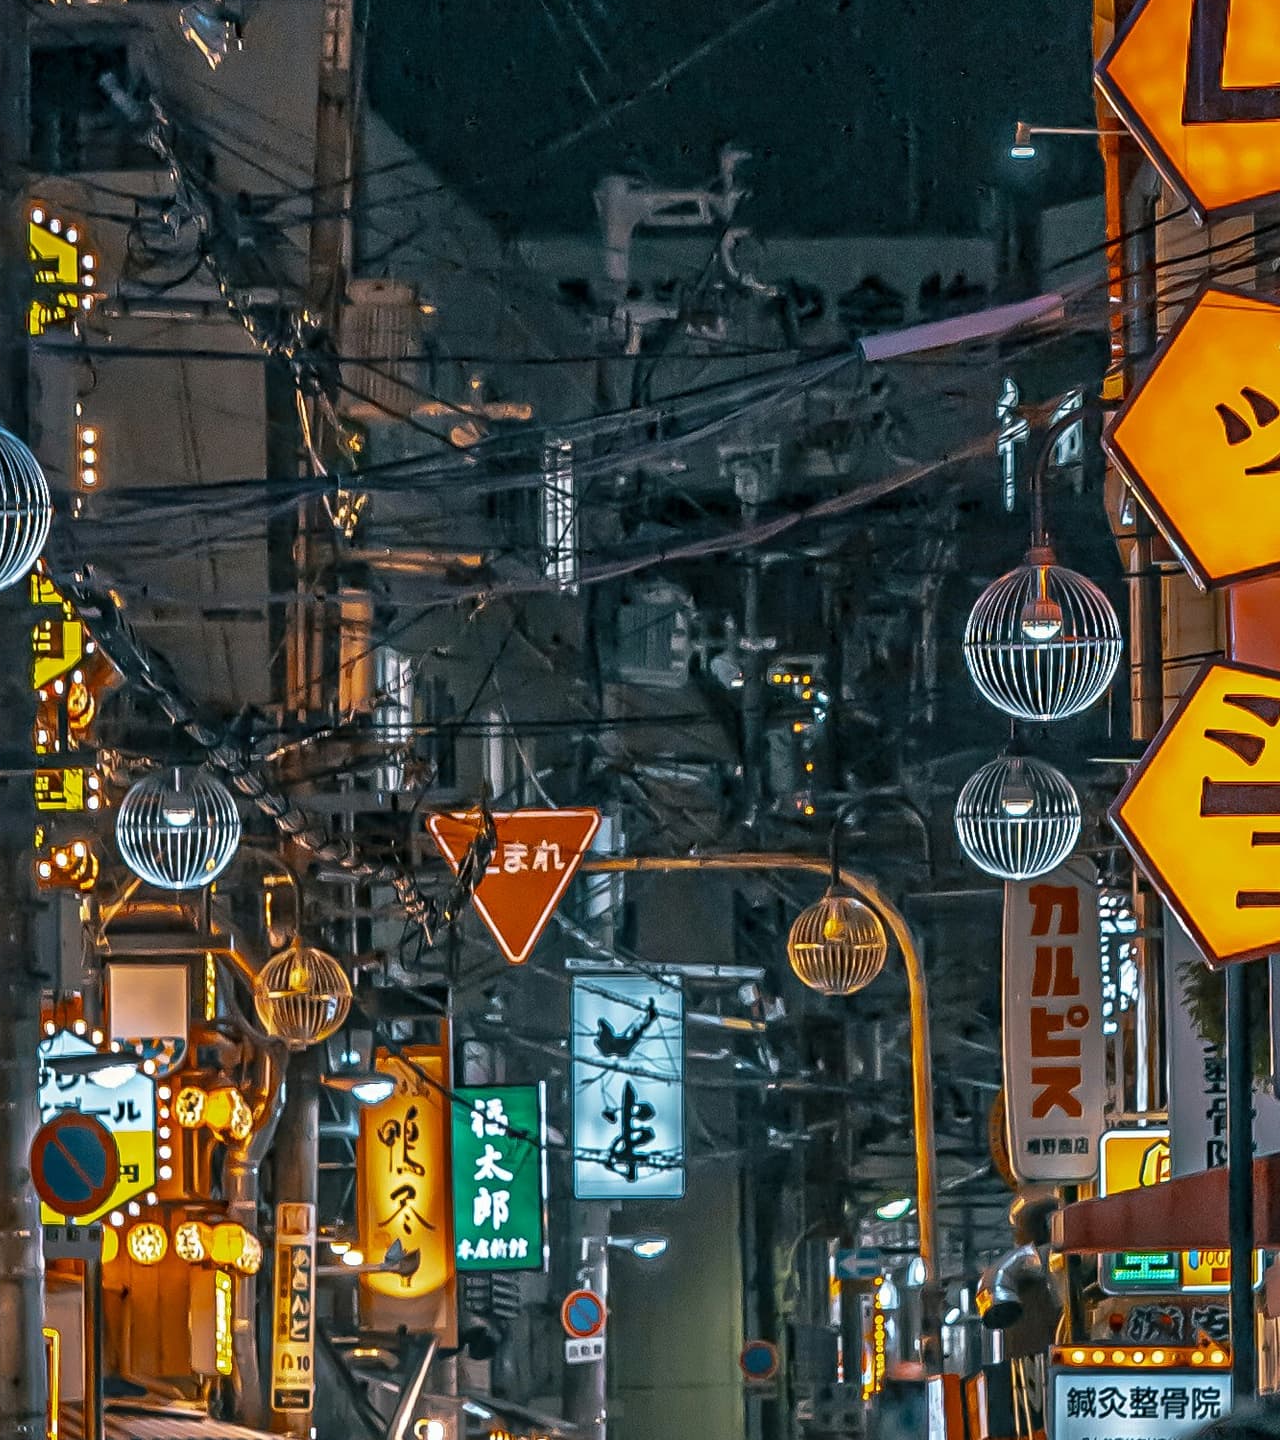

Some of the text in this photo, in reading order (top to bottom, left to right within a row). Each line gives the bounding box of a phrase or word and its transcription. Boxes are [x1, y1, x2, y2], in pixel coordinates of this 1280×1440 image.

[1028, 883, 1090, 1119] カルピス
[471, 1098, 513, 1231] 福太郎
[1067, 1386, 1222, 1420] 鍼灸整骨院
